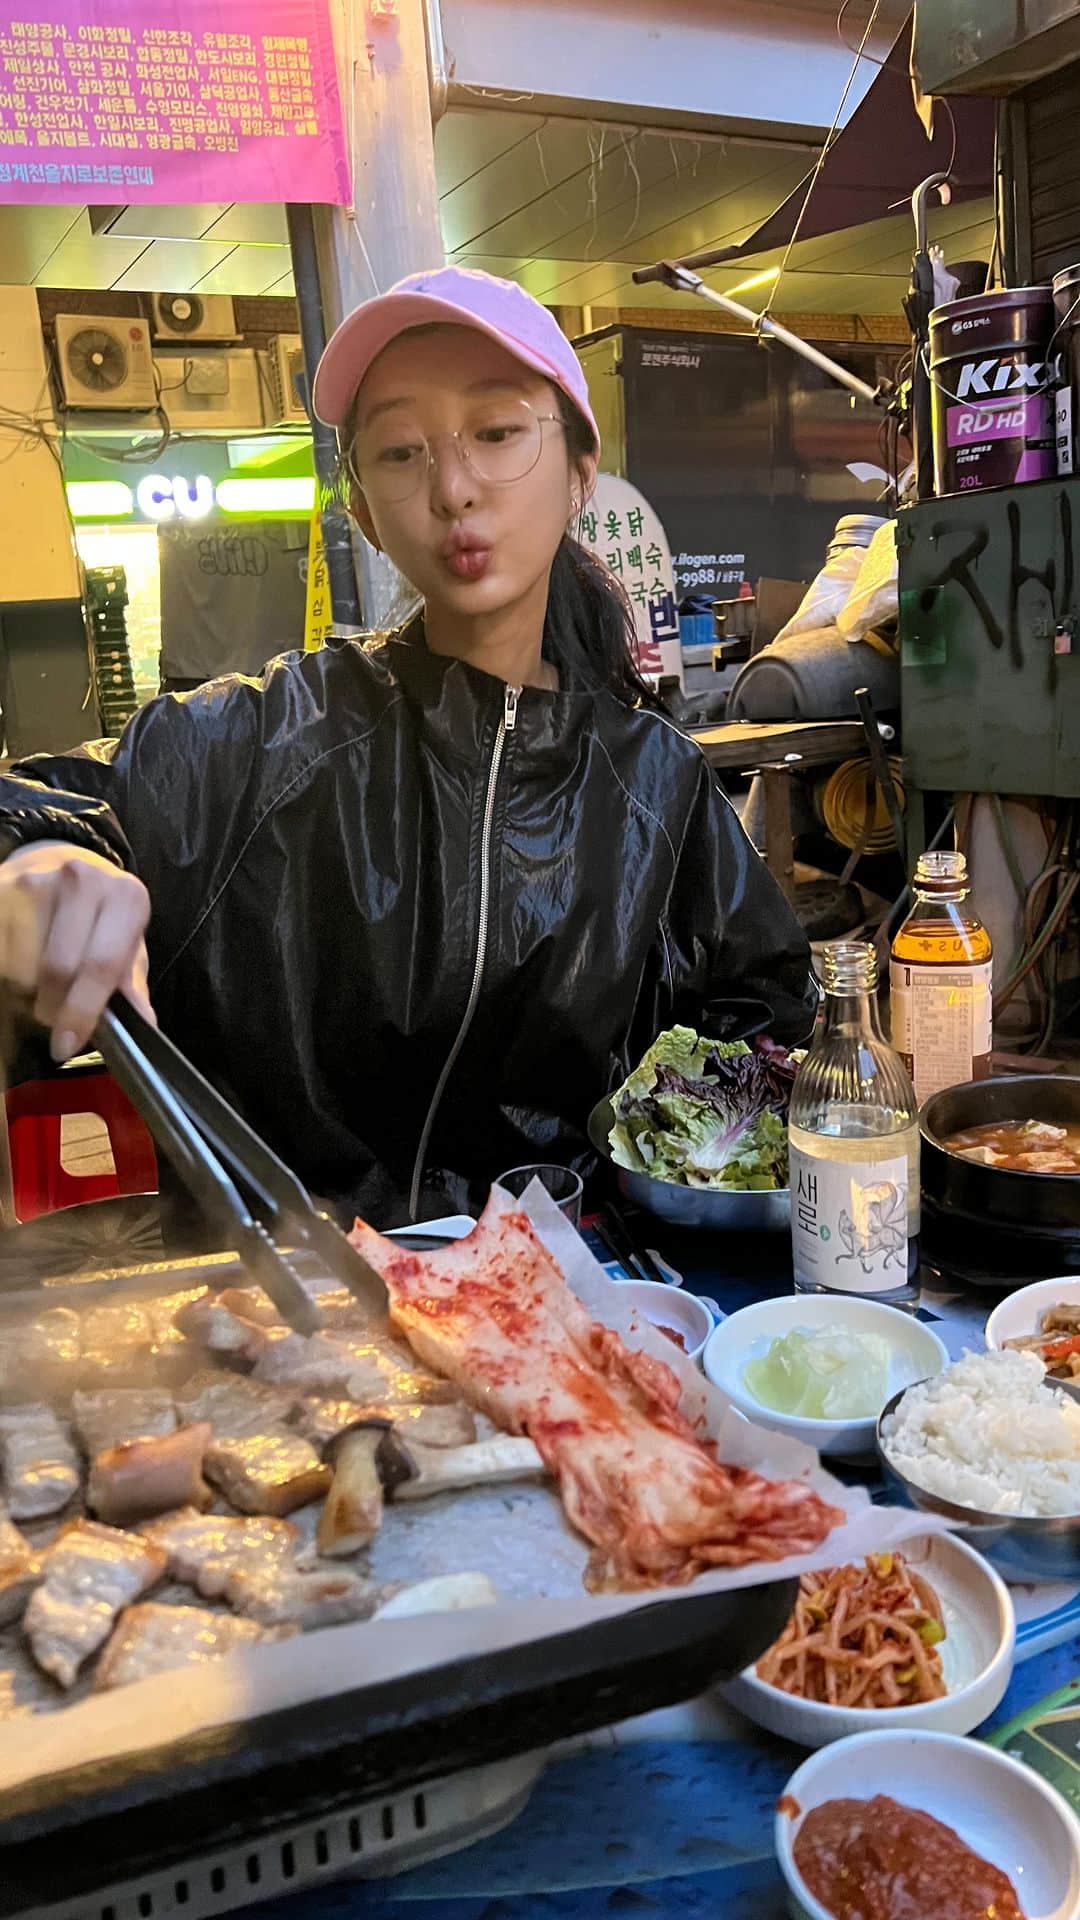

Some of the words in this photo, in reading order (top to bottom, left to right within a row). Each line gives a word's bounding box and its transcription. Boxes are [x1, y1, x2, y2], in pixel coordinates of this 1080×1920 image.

[996, 411, 1026, 430] HD
[959, 473, 983, 489] 20L
[136, 474, 215, 520] CU
